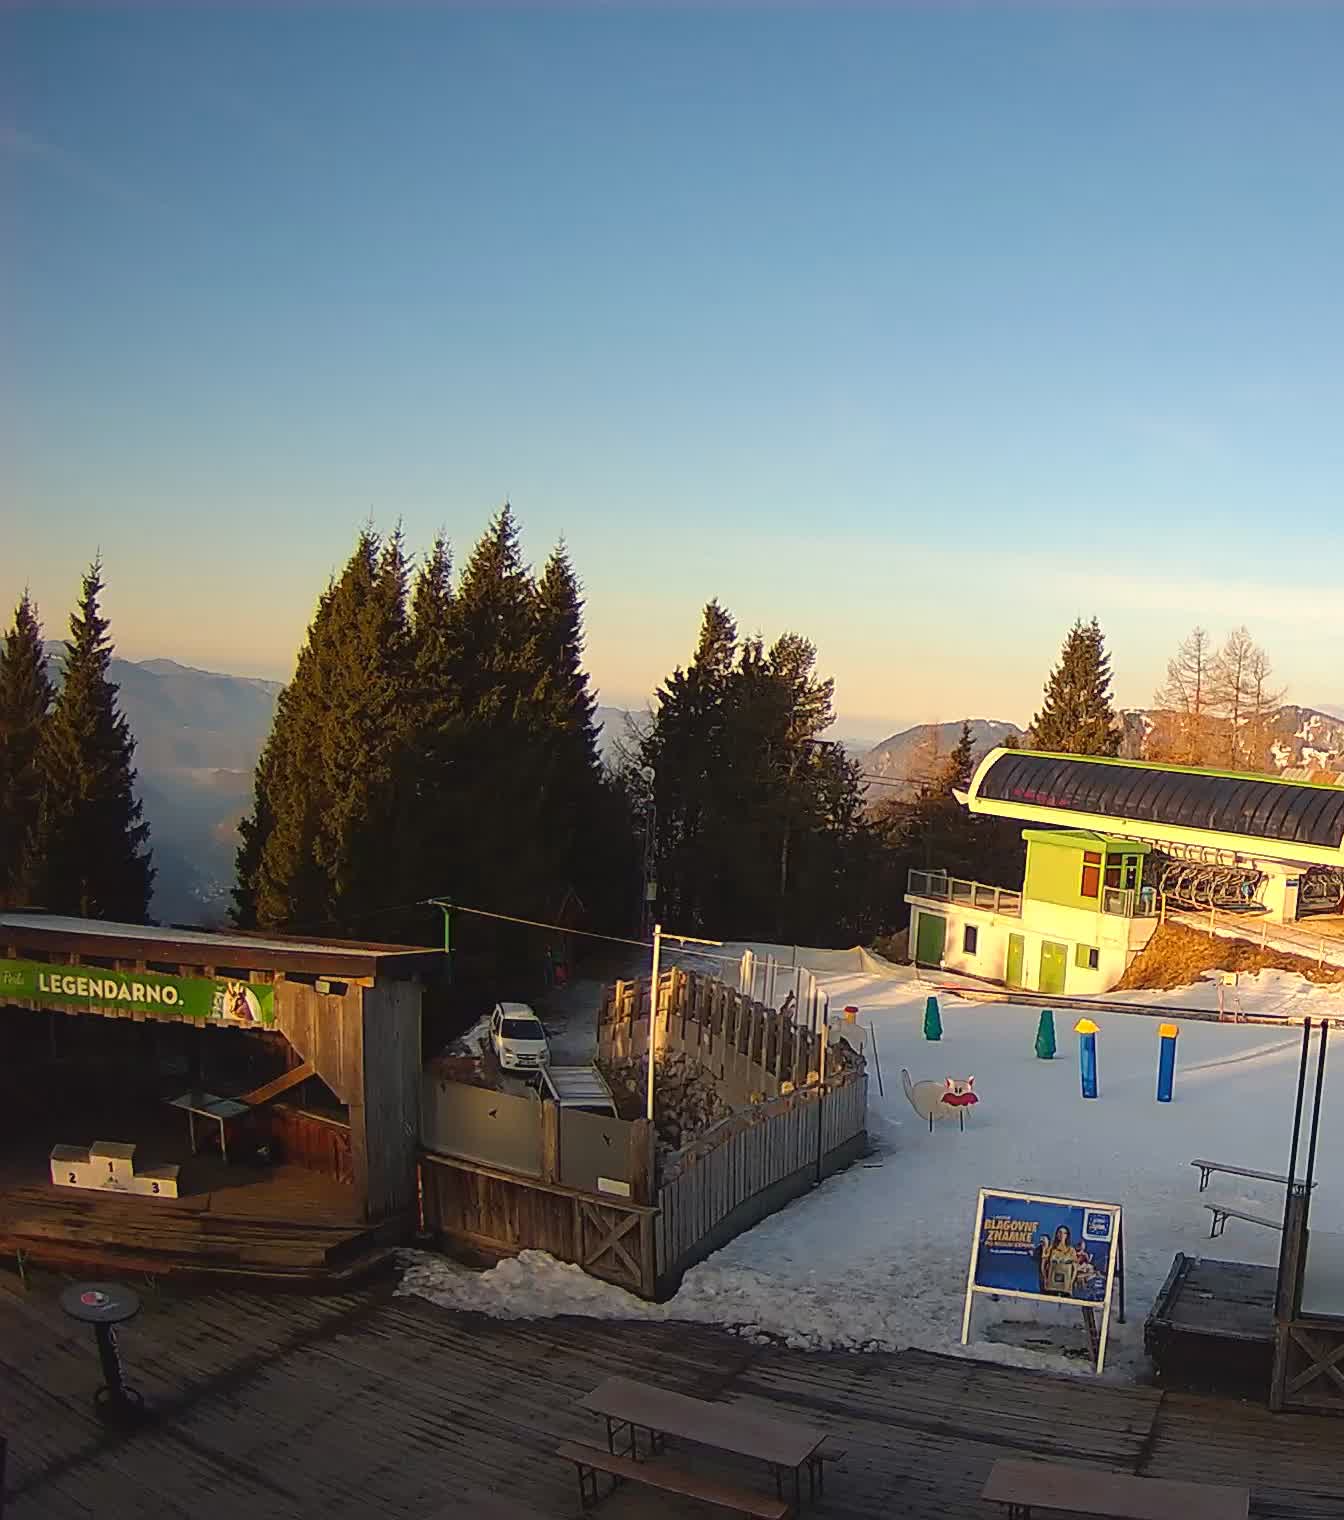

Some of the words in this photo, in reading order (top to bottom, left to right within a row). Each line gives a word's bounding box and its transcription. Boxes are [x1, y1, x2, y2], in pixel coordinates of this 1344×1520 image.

[39, 973, 184, 1006] LEGENDARNO.
[108, 1161, 114, 1173] 1
[68, 1172, 77, 1184] 2
[151, 1182, 160, 1194] 3
[984, 1218, 1039, 1232] BLAGOVNE
[987, 1230, 1033, 1243] ZNAMKE
